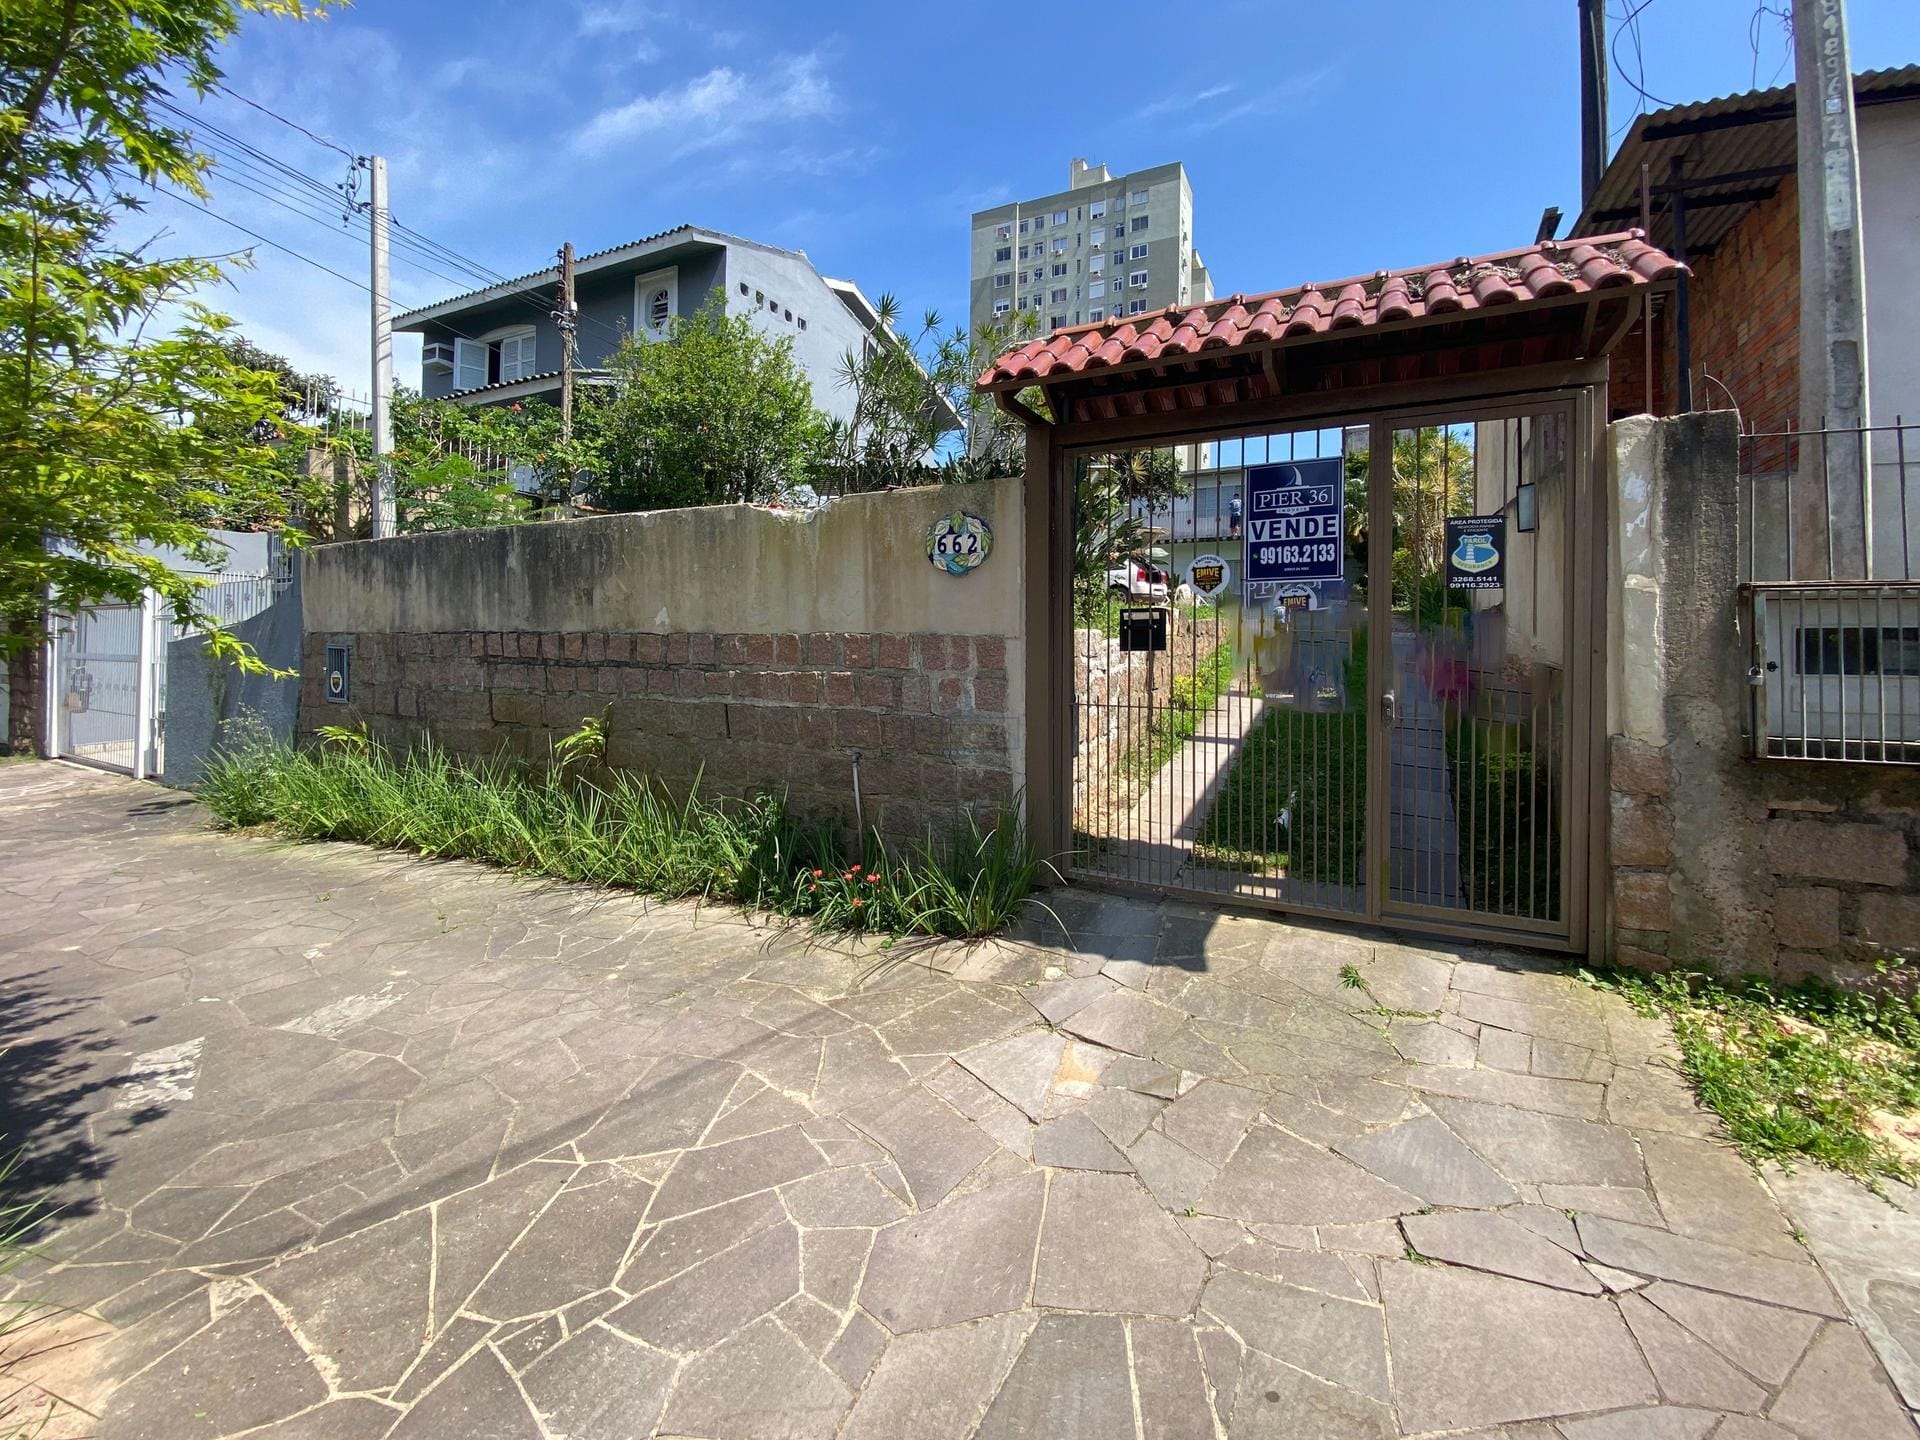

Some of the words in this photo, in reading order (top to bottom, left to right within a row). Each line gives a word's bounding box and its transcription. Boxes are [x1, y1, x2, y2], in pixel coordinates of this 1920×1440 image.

[1259, 491, 1304, 508] PIER
[1309, 489, 1328, 504] 36
[1250, 516, 1337, 540] VENDE
[938, 533, 978, 555] 662
[1260, 543, 1335, 564] 99163.2133
[1196, 567, 1220, 579] EMIVE
